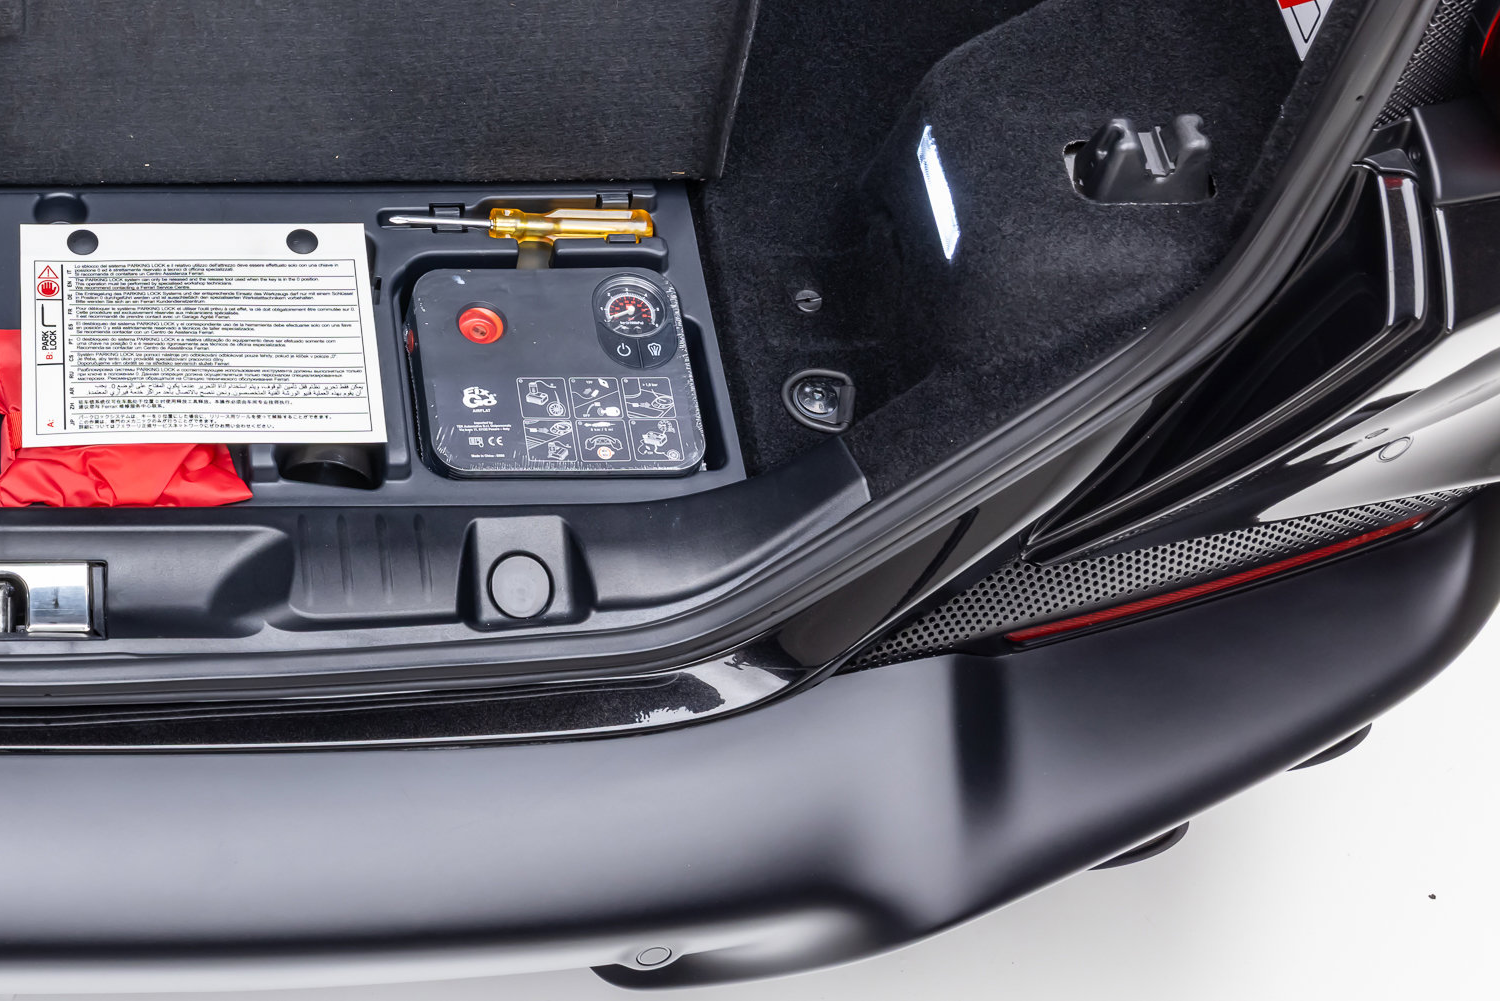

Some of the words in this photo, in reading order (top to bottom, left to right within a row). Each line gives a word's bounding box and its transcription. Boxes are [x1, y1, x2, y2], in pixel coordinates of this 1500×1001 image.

[46, 351, 53, 359] B:
[47, 419, 54, 428] A:
[488, 436, 503, 446] CE
